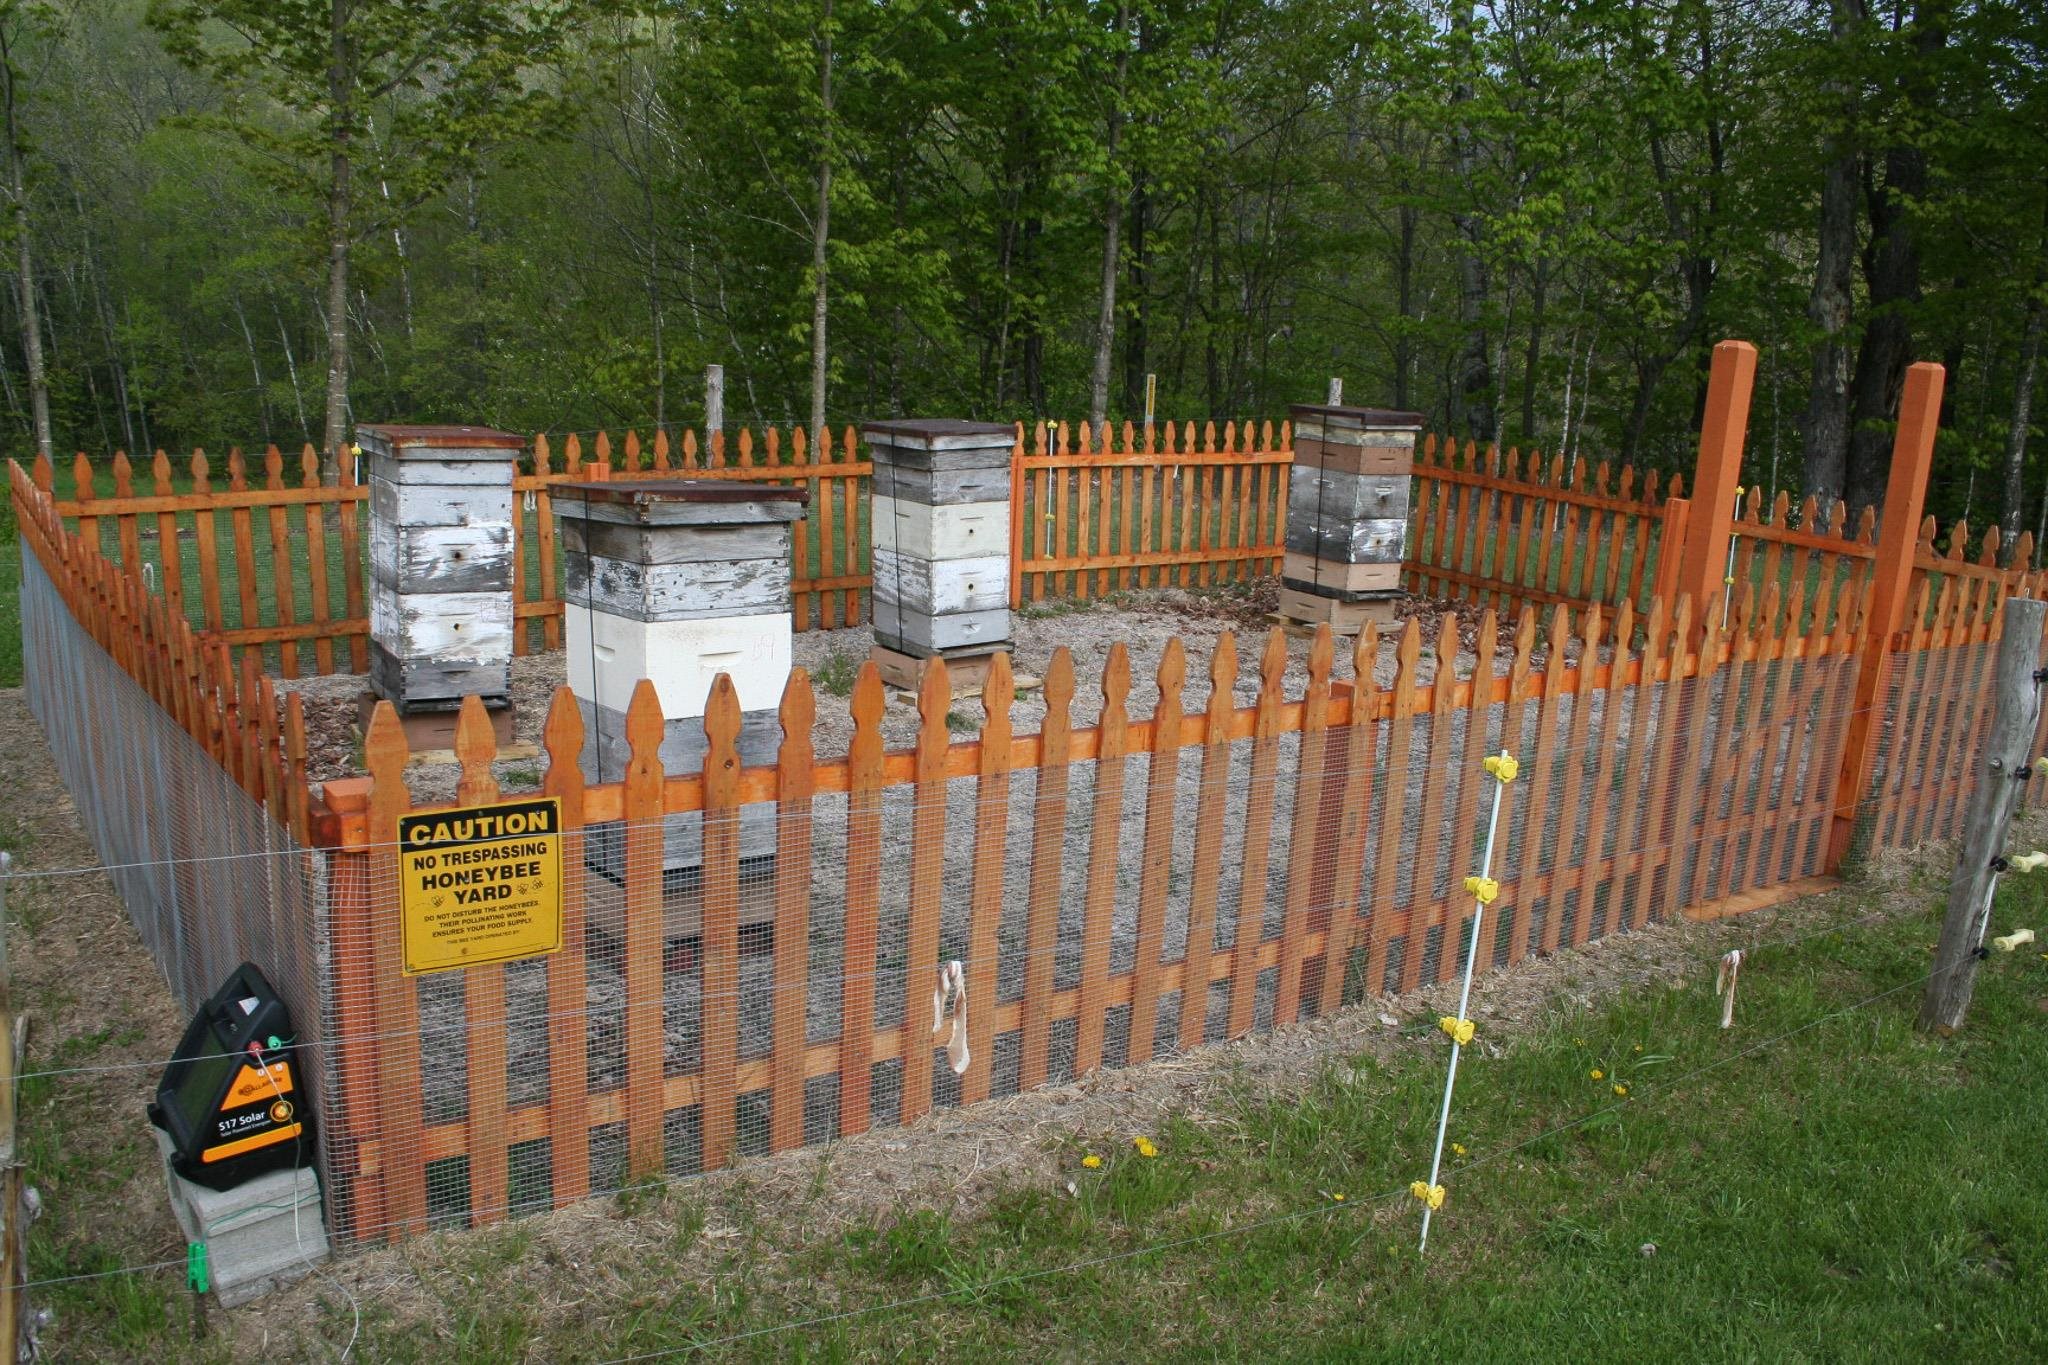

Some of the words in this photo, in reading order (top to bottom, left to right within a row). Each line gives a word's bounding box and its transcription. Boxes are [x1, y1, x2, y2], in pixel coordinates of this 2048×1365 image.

[409, 811, 548, 846] CAUTION
[414, 856, 437, 871] NO
[441, 842, 547, 866] TRESPASSING
[421, 860, 542, 891] HONEYBEE
[453, 884, 512, 905] YARD
[436, 912, 451, 921] NOT
[452, 908, 483, 918] DISTURB
[484, 905, 498, 914] THE
[439, 920, 460, 928] THEIR
[461, 913, 505, 925] POLLINATING
[507, 910, 527, 918] WORK
[432, 928, 465, 938] ENSURES
[466, 924, 486, 933] YOUR
[487, 921, 506, 929] FOOD
[218, 1118, 237, 1132] S17
[239, 1111, 266, 1126] Solar
